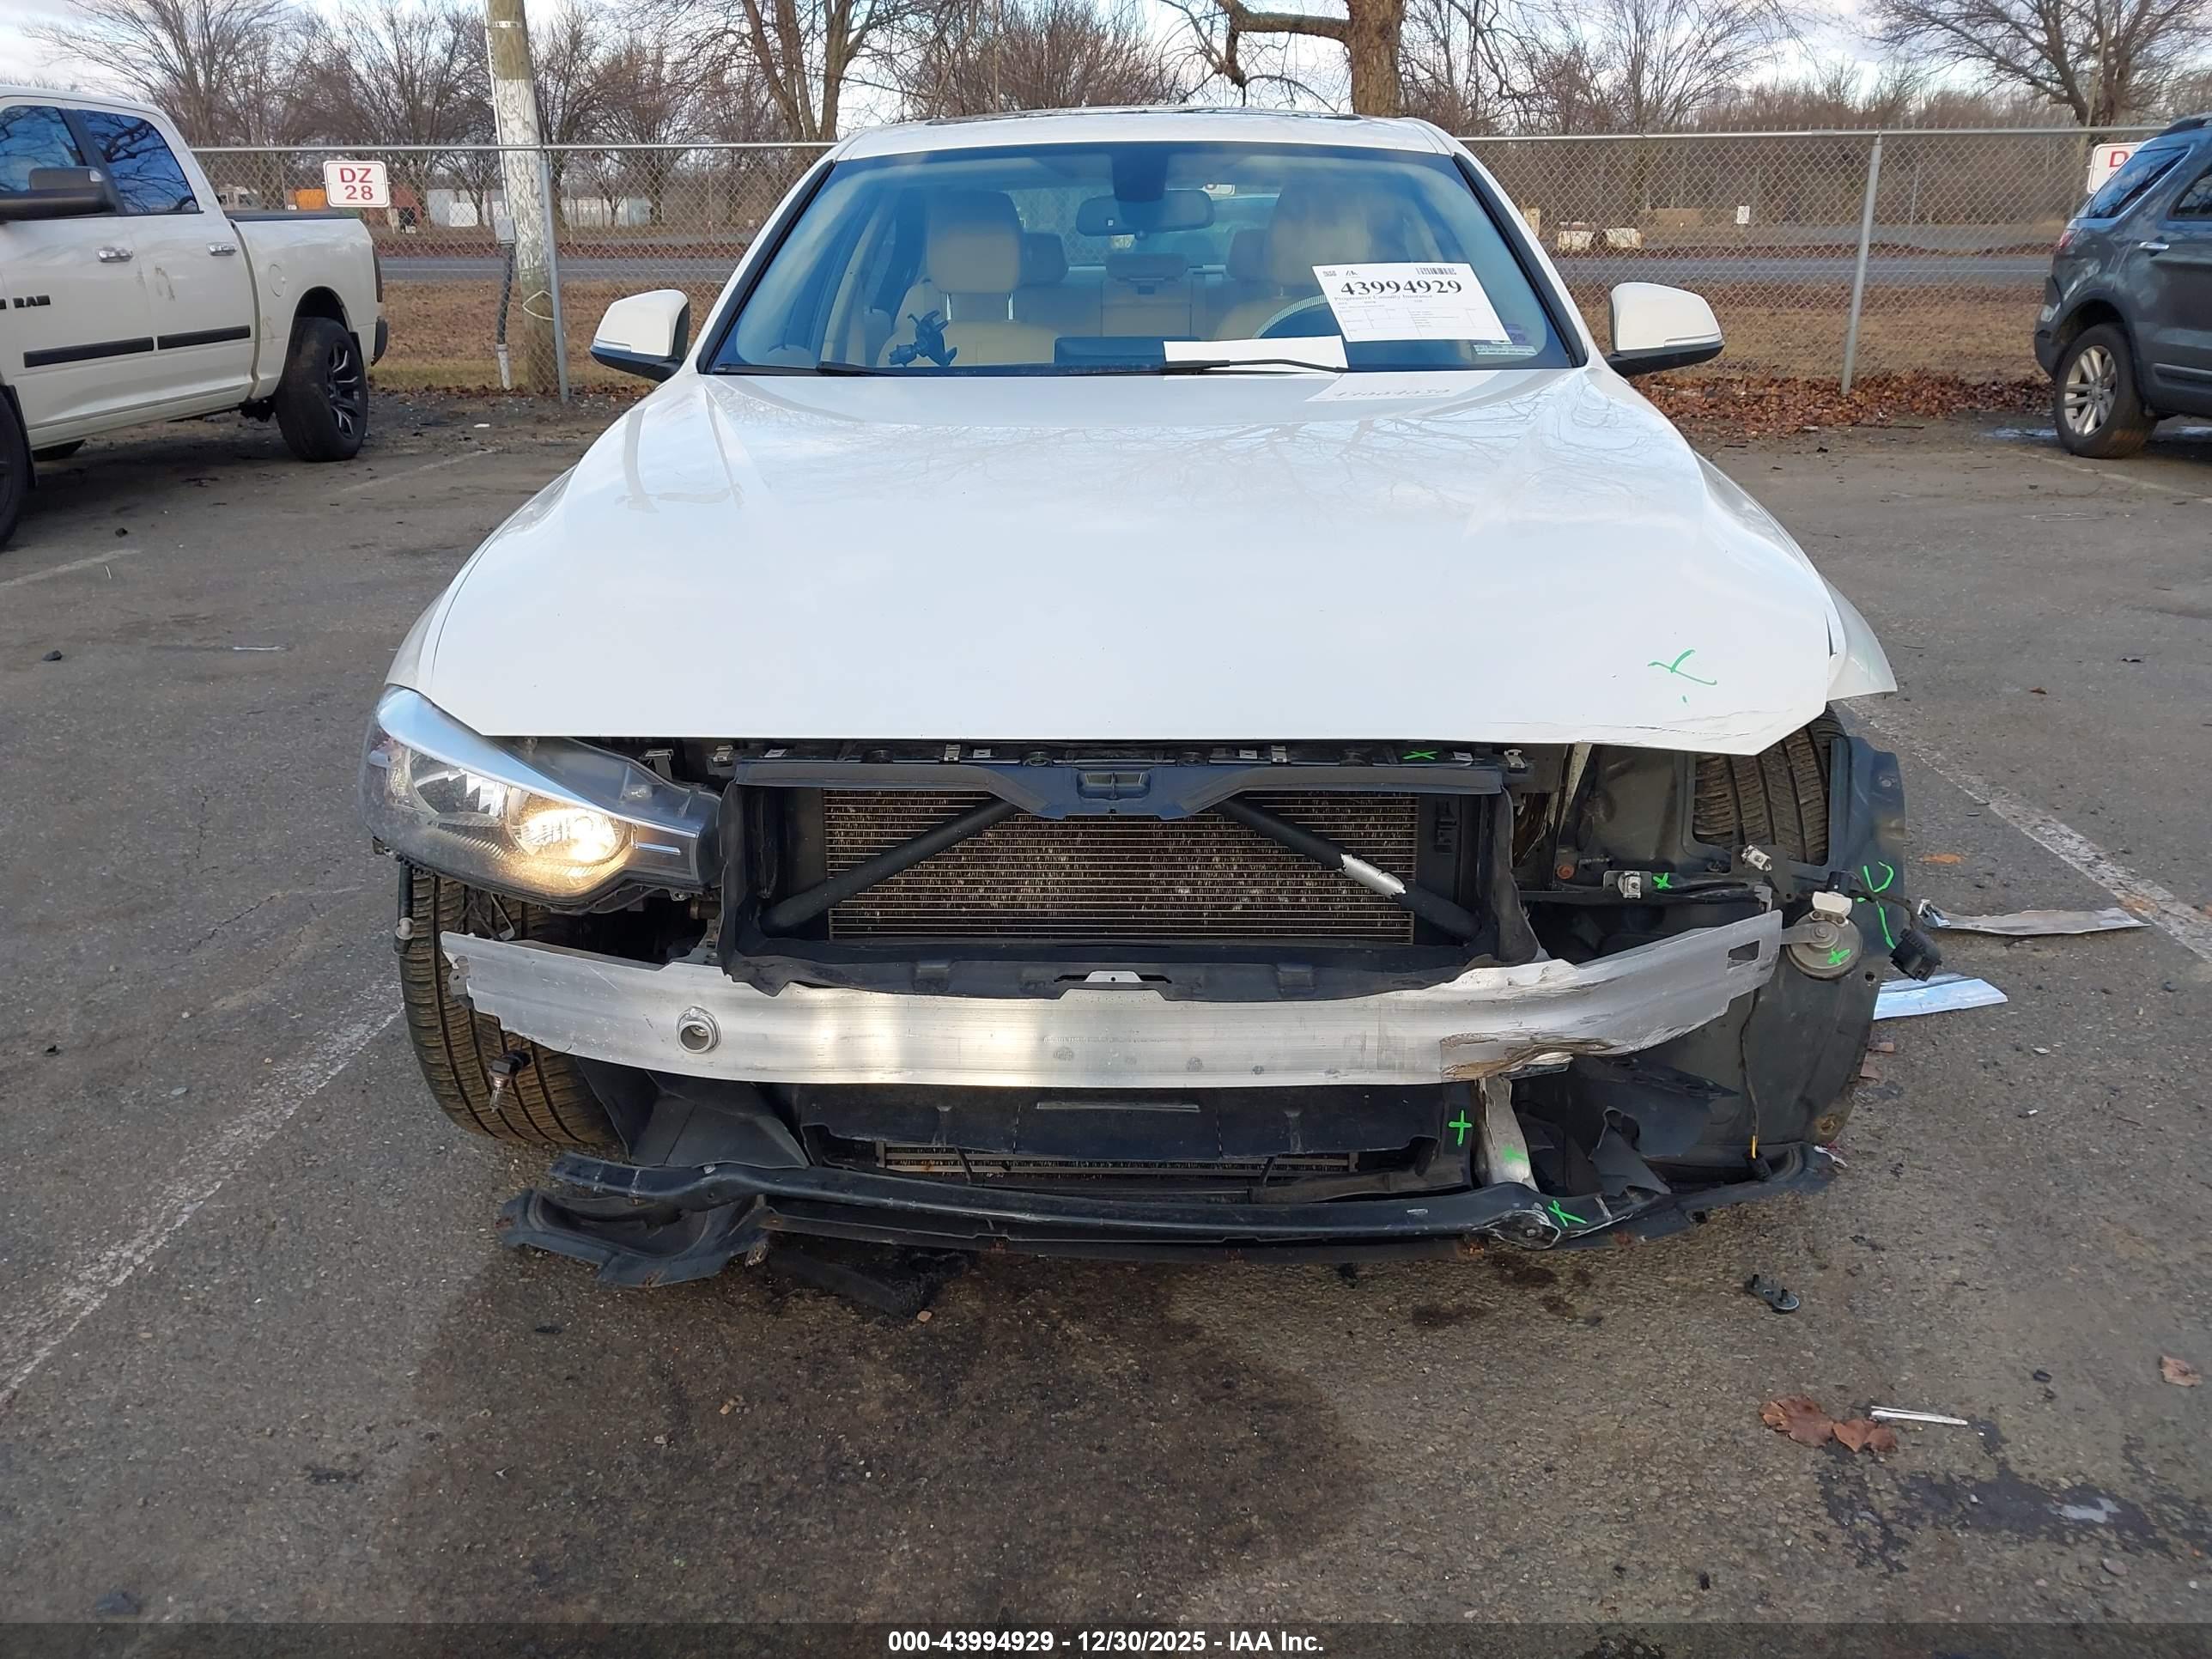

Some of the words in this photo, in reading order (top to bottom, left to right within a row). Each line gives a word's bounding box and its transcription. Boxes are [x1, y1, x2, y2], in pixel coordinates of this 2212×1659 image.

[2109, 150, 2130, 168] D
[339, 167, 374, 183] DZ
[344, 185, 374, 200] 28
[1340, 279, 1462, 295] 43994929
[13, 295, 51, 308] RAM
